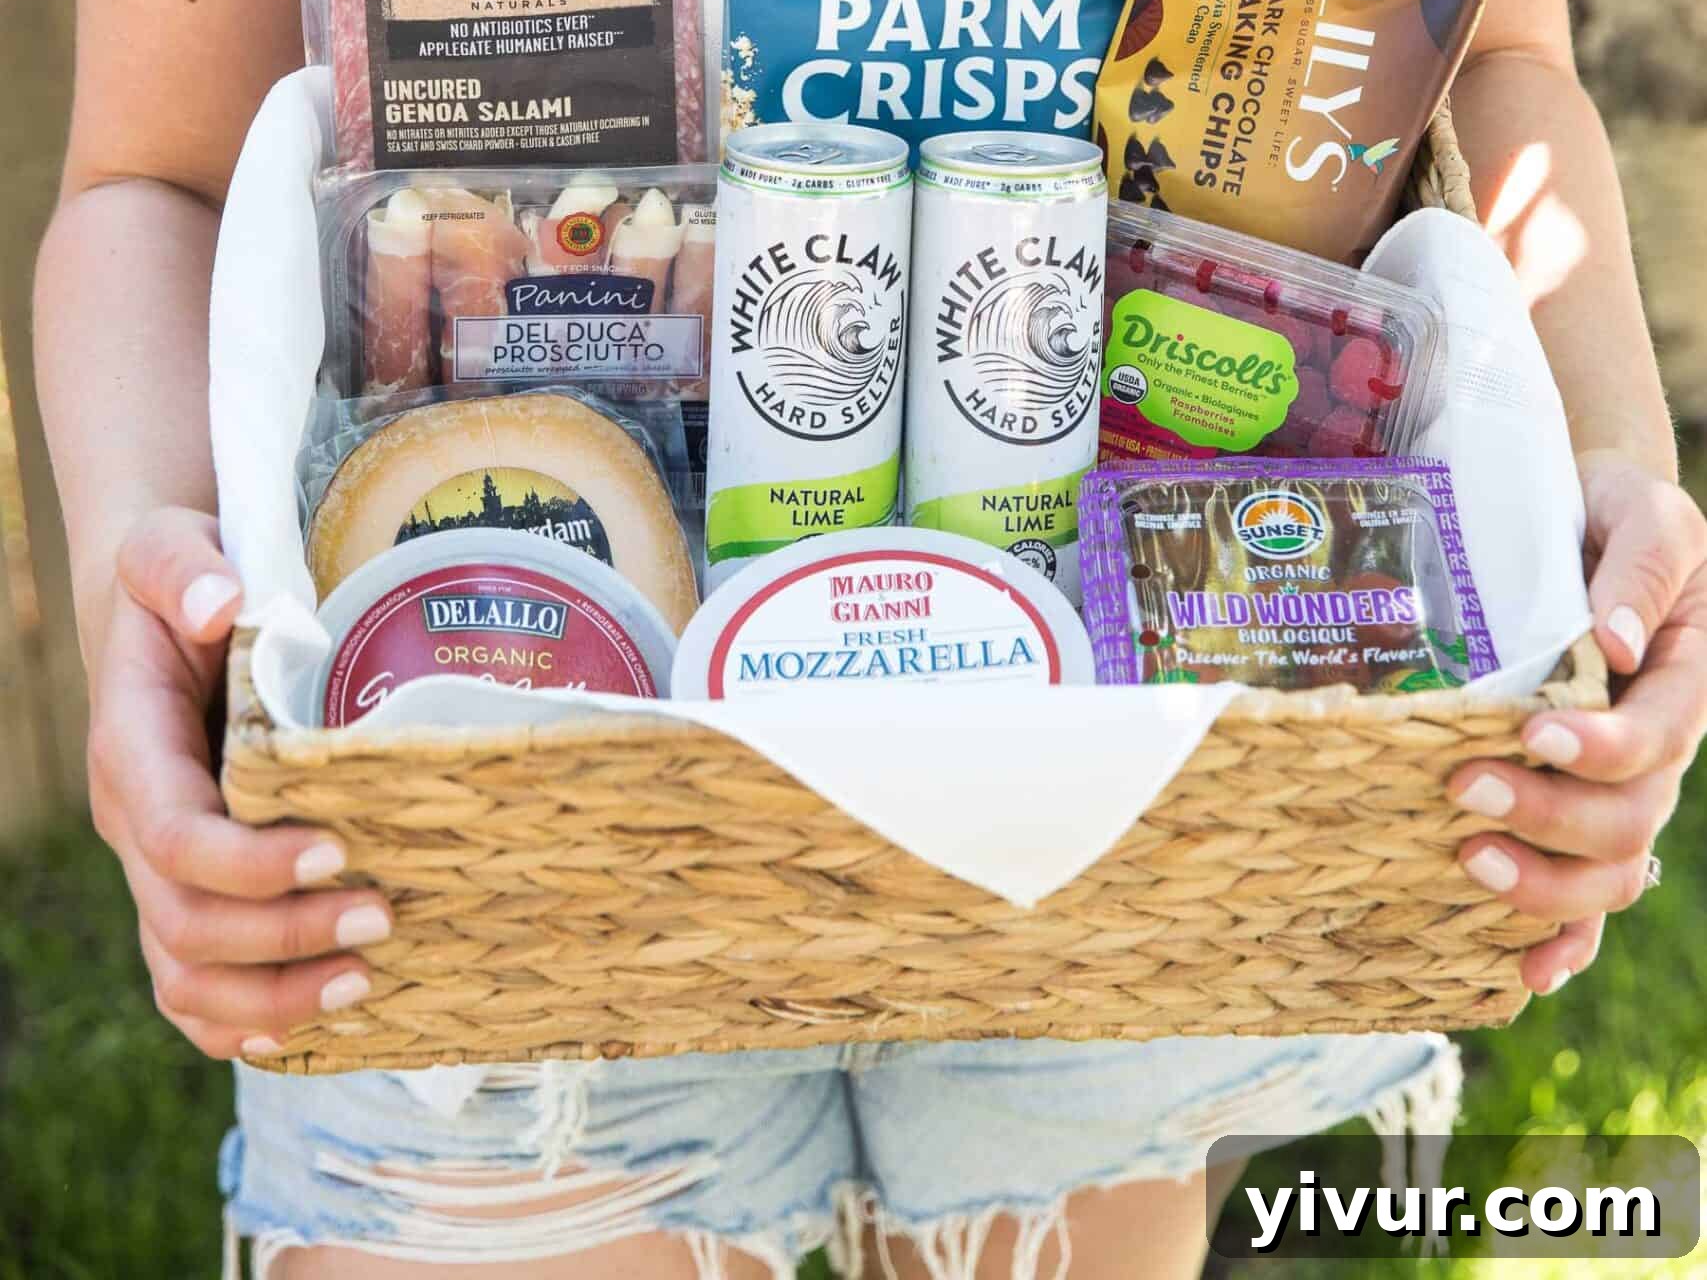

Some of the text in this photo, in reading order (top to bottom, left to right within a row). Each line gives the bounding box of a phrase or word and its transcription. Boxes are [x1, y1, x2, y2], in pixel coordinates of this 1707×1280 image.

[450, 23, 468, 38] NO
[473, 19, 552, 37] ANTIBIOTICS
[1186, 4, 1210, 45] Cacao
[419, 40, 492, 57] APPLEGATE
[496, 35, 564, 54] HUMANELY
[1188, 21, 1222, 93] Sweetened
[383, 78, 482, 101] UNCURED
[782, 56, 1102, 130] CRISPS
[1279, 77, 1297, 126] SWEET
[385, 96, 572, 123] GENOA SALAMI
[1222, 45, 1275, 197] CHOCOLATE
[386, 115, 650, 140] NO NITRATES OR NITRITES ADDED EXCEPT THOSE NATURALLY OCCURRING IN
[387, 141, 400, 152] SEA
[401, 141, 418, 152] SALT
[420, 140, 434, 152] AND
[436, 140, 458, 151] SWISS
[459, 139, 483, 151] CHARD
[484, 138, 514, 150] POWDER
[520, 136, 547, 149] GLUTEN
[556, 133, 580, 147] CASEIN
[582, 131, 600, 145] FREE
[1194, 91, 1235, 187] CHIPS
[740, 167, 756, 180] MADE
[805, 179, 834, 189] CARBS
[846, 177, 875, 188] GLUTEN
[876, 173, 892, 185] FREE
[1014, 182, 1042, 192] CARBS
[512, 281, 647, 312] Panini
[730, 233, 903, 355] WHITE CLAW
[935, 235, 1103, 364] WHITE CLAW
[506, 323, 557, 344] DEL
[493, 343, 665, 363] PROSCIUTTO
[1122, 314, 1287, 396] Driscoll's
[755, 316, 901, 430] HARD SELTZER
[964, 319, 1102, 435] HARD SELTZER
[1117, 371, 1141, 388] USDA
[1137, 353, 1259, 402] Only the Finest Berries
[1153, 378, 1259, 421] Organic Biologiques
[1170, 396, 1236, 426] Raspberries
[1172, 408, 1237, 438] Framboises
[769, 486, 866, 507] NATURAL
[980, 488, 1074, 513] NATURAL
[791, 508, 845, 527] LIME
[1004, 514, 1055, 533] LIME
[1238, 523, 1324, 542] SUNSET
[829, 570, 935, 601] MAURO
[1244, 565, 1332, 583] ORGANIC
[364, 590, 407, 627] INFORMATION
[430, 600, 558, 633] DELALLO
[830, 595, 933, 623] GIANNI
[1167, 587, 1418, 629] WILD WONDERS
[581, 600, 623, 641] REFRIGERATE
[619, 640, 638, 663] AFTER
[842, 628, 929, 648] FRESH
[1238, 627, 1359, 644] BIOLOGIQUE
[434, 646, 553, 670] ORGANIC
[738, 636, 1036, 681] MOZZARELLA
[1176, 647, 1250, 665] Discover
[1254, 650, 1288, 666] The
[1292, 648, 1357, 666] World's
